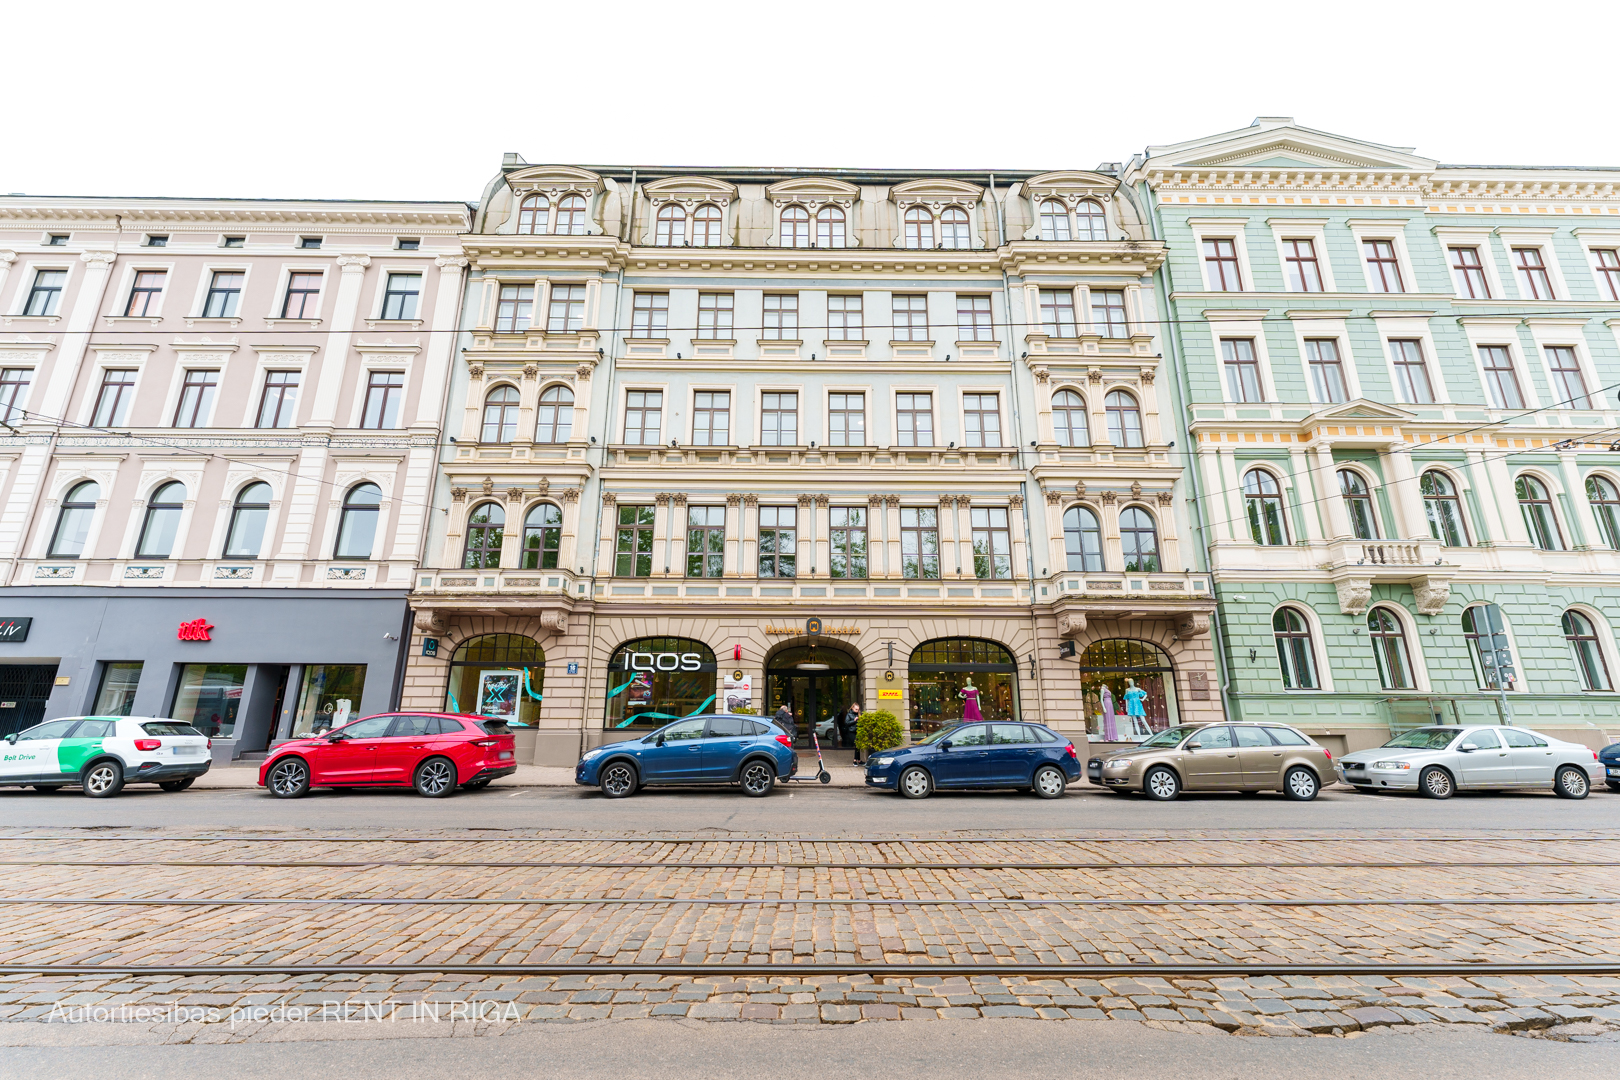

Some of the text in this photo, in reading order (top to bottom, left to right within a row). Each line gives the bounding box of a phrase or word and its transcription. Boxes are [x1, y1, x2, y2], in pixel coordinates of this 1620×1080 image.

[765, 625, 803, 636] Basteja
[624, 652, 701, 673] IQOS
[4, 753, 36, 763] Bolt Drive
